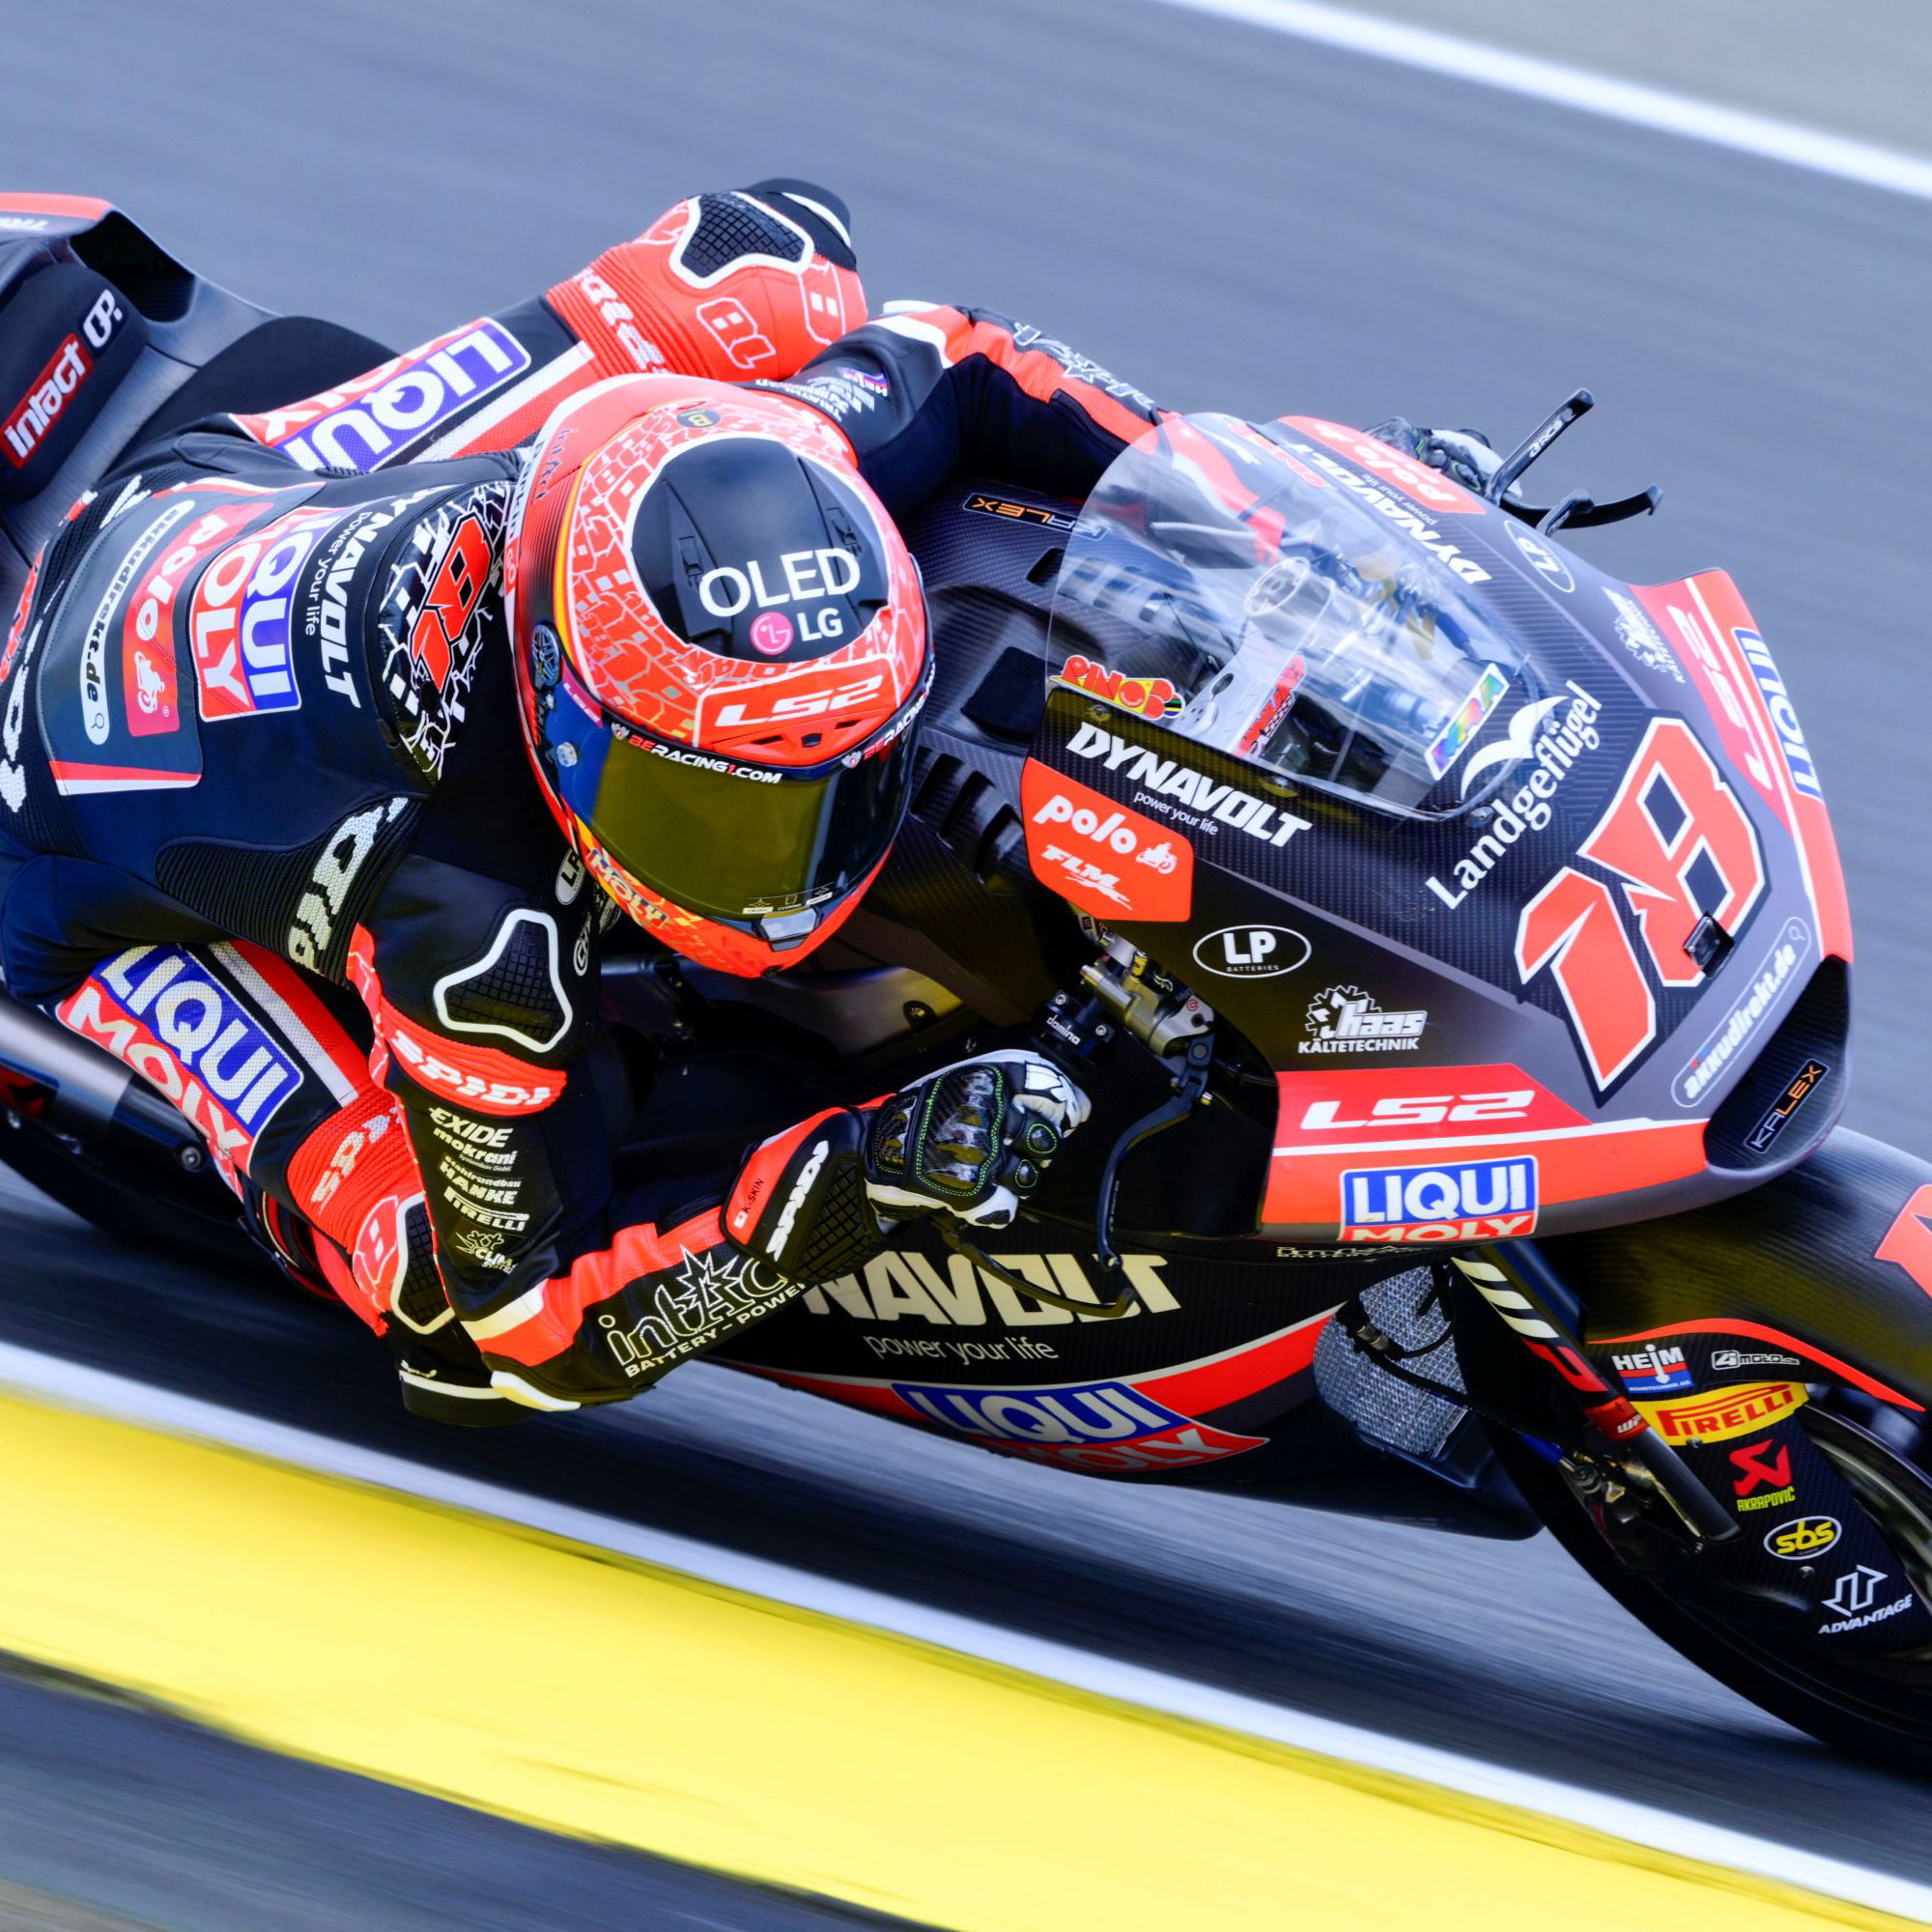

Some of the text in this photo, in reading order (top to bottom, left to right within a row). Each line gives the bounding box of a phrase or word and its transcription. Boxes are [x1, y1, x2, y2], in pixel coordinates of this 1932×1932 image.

[135, 514, 228, 641] polo
[304, 511, 373, 637] power your life
[698, 548, 861, 617] OLED
[797, 608, 844, 642] LG
[714, 673, 884, 727] LS2
[1740, 636, 1823, 796] LIQUI
[627, 732, 783, 784] BERACING1.COM
[1065, 721, 1313, 848] DYNAVOLT
[1425, 678, 1603, 911] Landgeflügel
[1032, 794, 1138, 854] polo
[1133, 791, 1219, 836] power your life
[1040, 843, 1122, 890] FLM
[1513, 715, 1768, 1094] 18
[1223, 930, 1277, 964] LP
[100, 945, 289, 1125] LIQUI
[1045, 1013, 1082, 1046] domino
[1297, 1037, 1420, 1055] KÄLTETECHNIK
[1335, 1001, 1428, 1039] haas
[67, 985, 251, 1158] MOLY
[391, 1029, 551, 1106] SPIDI
[428, 1106, 514, 1149] EXIDE
[1299, 1090, 1536, 1130] LS2
[1749, 1064, 1824, 1150] KALEX
[433, 1126, 519, 1165] mokrani
[440, 1161, 519, 1206] HANKE
[443, 1185, 530, 1233] PIRELLI
[743, 1178, 765, 1213] K-SKIN
[765, 1140, 830, 1263] SPIDI
[1352, 1163, 1526, 1224] LIQUI
[1350, 1215, 1532, 1242] MOLY
[803, 1250, 1182, 1326] NAVOLT
[624, 1328, 719, 1378] BATTERY
[862, 1335, 1060, 1366] power your life
[908, 1387, 1171, 1445] LIQUI
[1656, 1383, 1794, 1437] PIRELLI
[1776, 1520, 1835, 1554] sbs
[1818, 1593, 1913, 1634] ADVANTAGE
